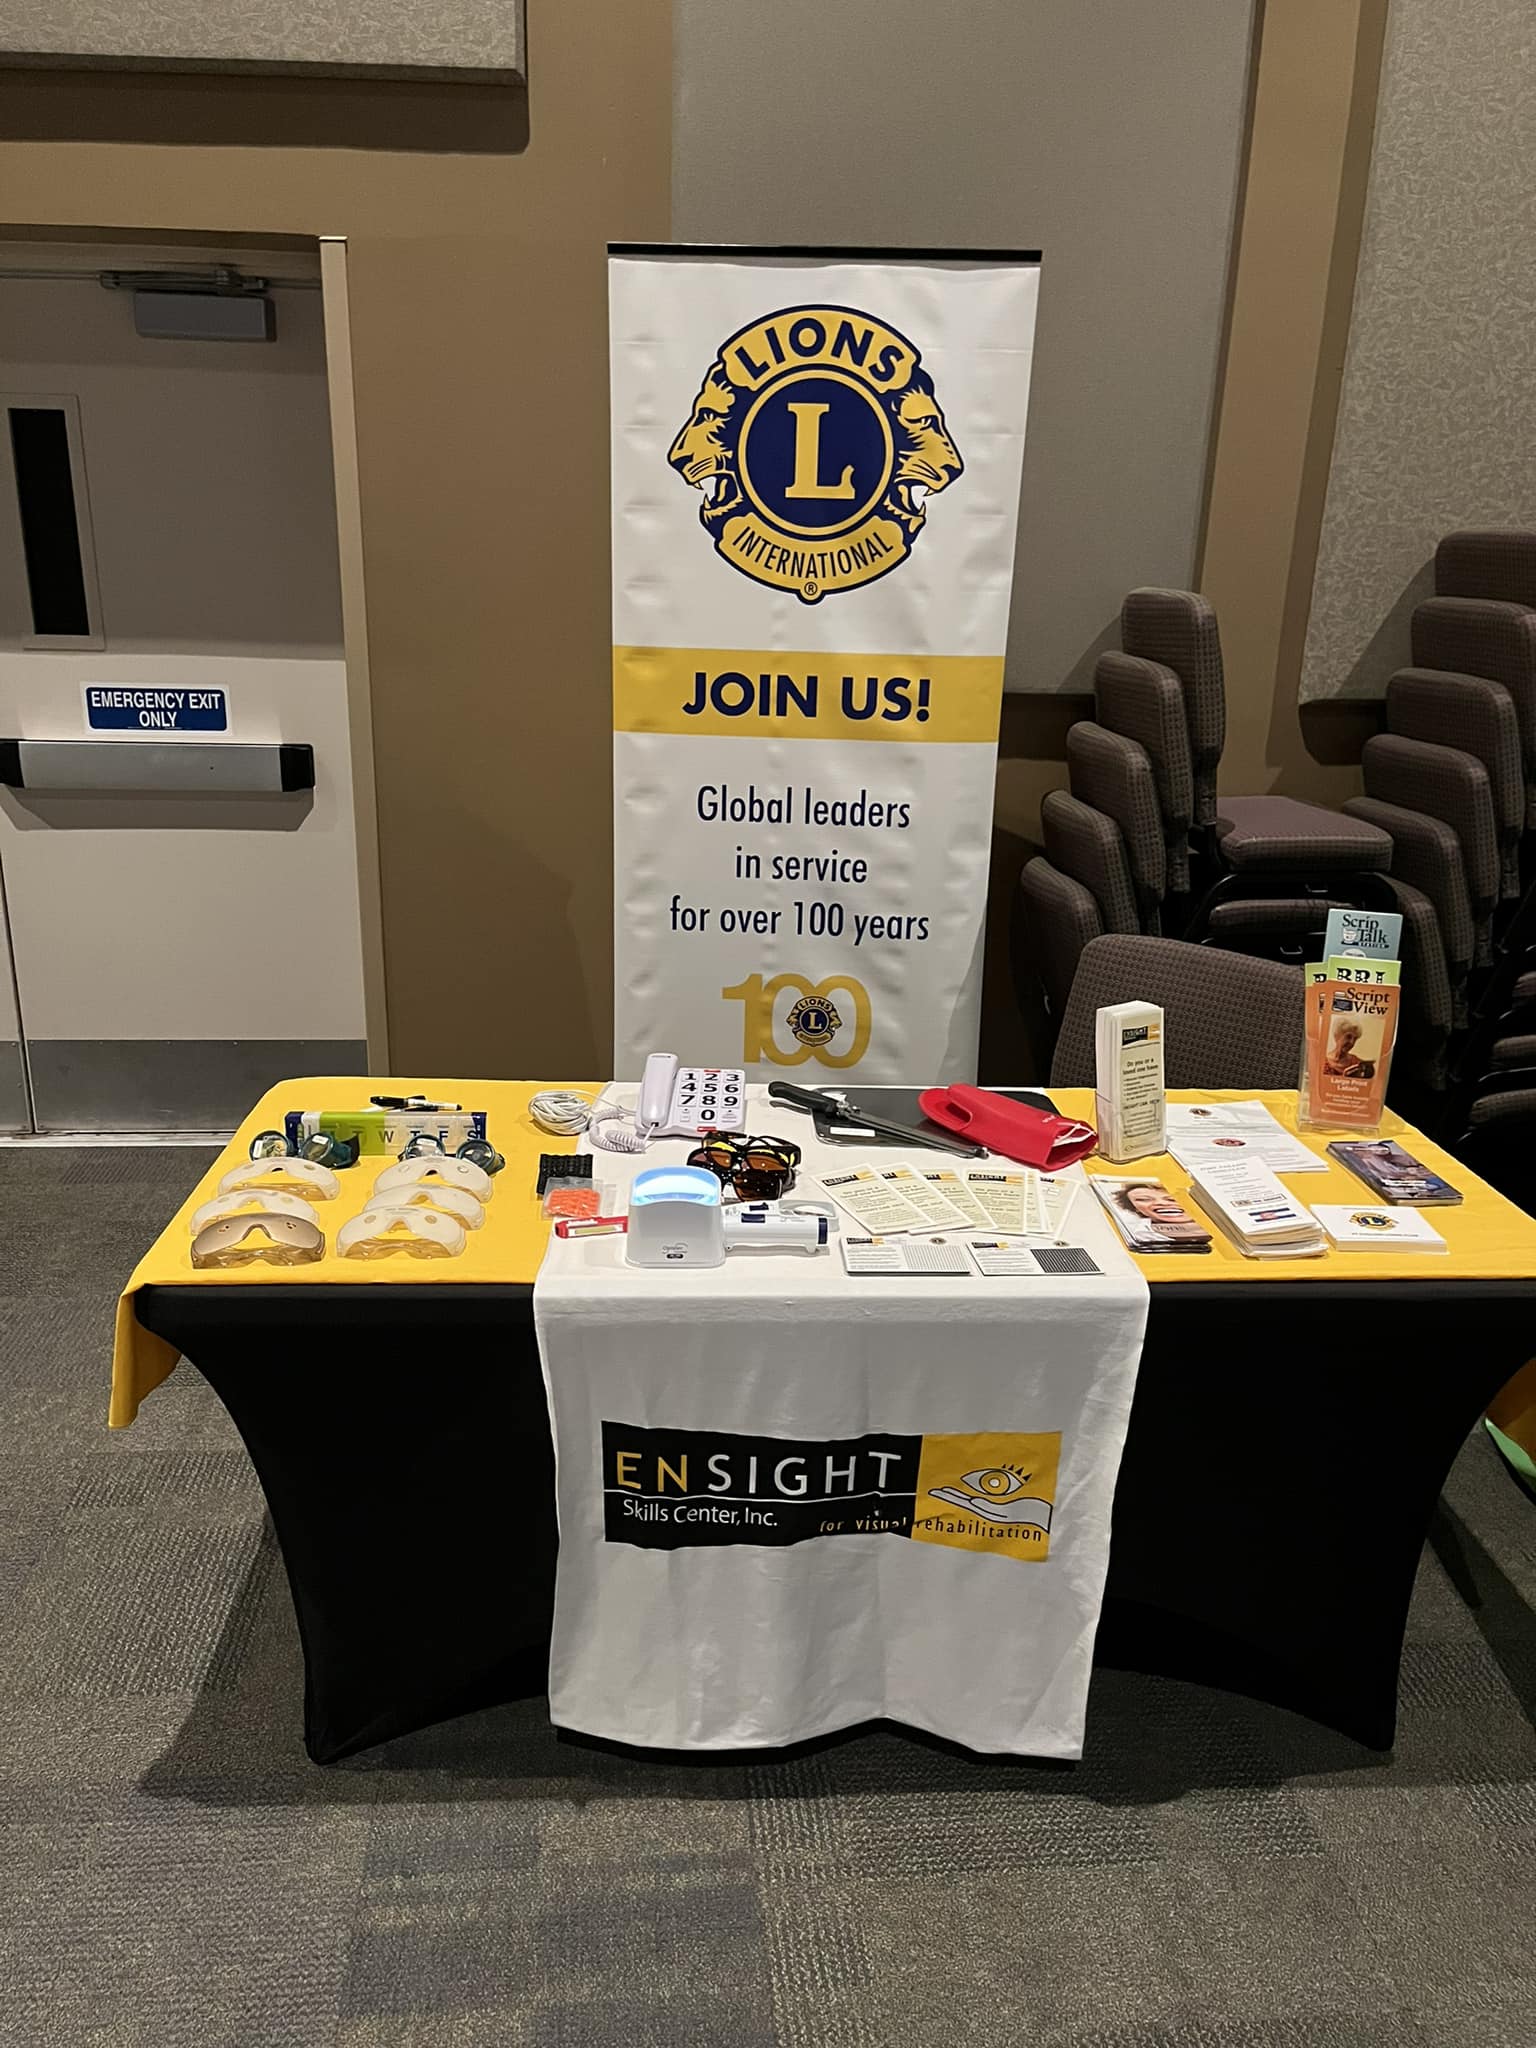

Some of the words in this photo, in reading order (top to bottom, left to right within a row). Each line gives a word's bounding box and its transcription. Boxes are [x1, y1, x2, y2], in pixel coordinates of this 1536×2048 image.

[735, 317, 904, 383] LIONS
[785, 402, 855, 500] L
[732, 526, 894, 579] INTERNATIONAL
[91, 691, 185, 709] EMERGENCY
[189, 693, 221, 710] EXIT
[682, 671, 819, 718] JOIN
[841, 676, 931, 722] US!
[139, 711, 177, 728] ONLY
[697, 785, 792, 824] Global
[804, 787, 910, 828] leaders
[735, 846, 761, 879] in
[771, 849, 868, 883] service
[670, 895, 710, 931] for
[719, 907, 781, 935] over
[794, 901, 844, 937] 100
[854, 914, 929, 946] years
[1342, 913, 1379, 932] Scrip
[1357, 929, 1390, 943] Talk
[799, 998, 831, 1010] LIONS
[1345, 986, 1391, 1005] Script
[1353, 1001, 1388, 1015] View
[722, 973, 872, 1069] 100
[808, 1011, 822, 1030] L
[685, 1073, 697, 1081] 1
[705, 1073, 719, 1081] 2
[681, 1082, 697, 1091] 4
[703, 1083, 718, 1092] 5
[724, 1084, 739, 1093] 6
[681, 1094, 695, 1105] 7
[702, 1095, 716, 1105] 8
[724, 1096, 738, 1106] 9
[700, 1109, 715, 1121] 0
[378, 1130, 394, 1143] W
[439, 1130, 449, 1143] F
[616, 1450, 902, 1496] ENSIGHT
[623, 1499, 669, 1522] Skills
[673, 1505, 741, 1526] Center,
[745, 1506, 778, 1527] Inc.
[820, 1520, 845, 1533] for
[856, 1515, 907, 1532] visual
[916, 1516, 1042, 1542] rehabilitation
